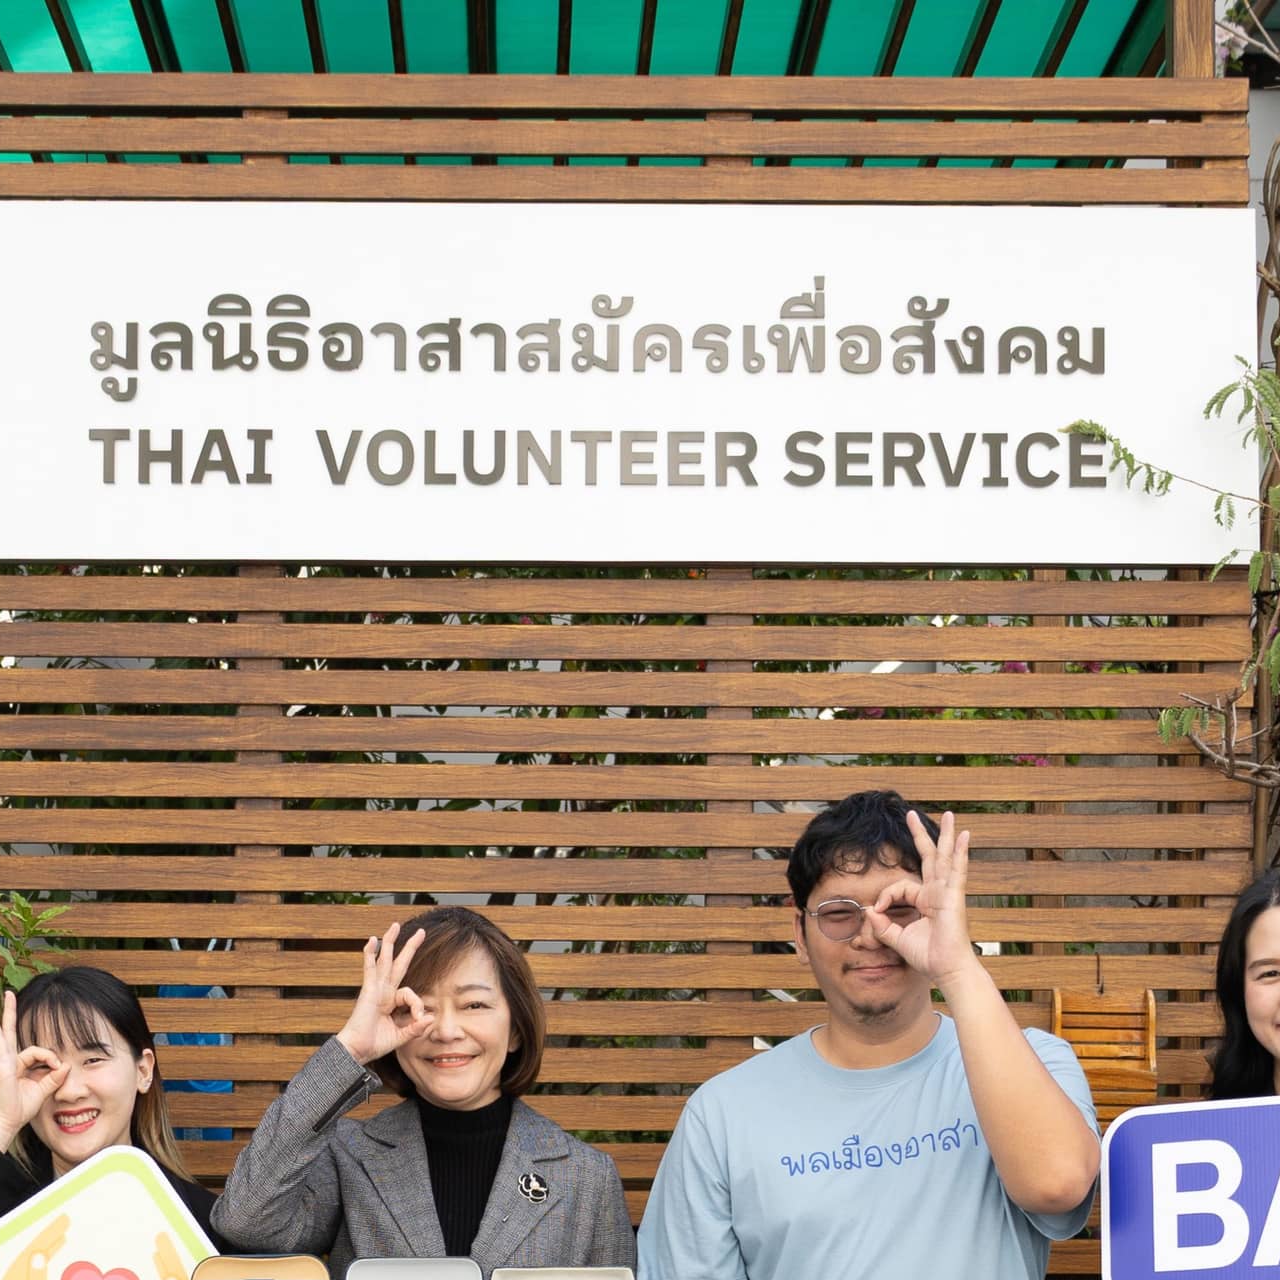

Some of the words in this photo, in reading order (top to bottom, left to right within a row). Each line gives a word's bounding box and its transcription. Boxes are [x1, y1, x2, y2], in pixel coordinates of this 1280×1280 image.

[90, 275, 1106, 402] มูลนิธิอาสาสมัครเพื่อสังคม
[88, 428, 273, 486] THAI
[315, 428, 760, 488] VOLUNTEER
[783, 428, 1108, 488] SERVICE
